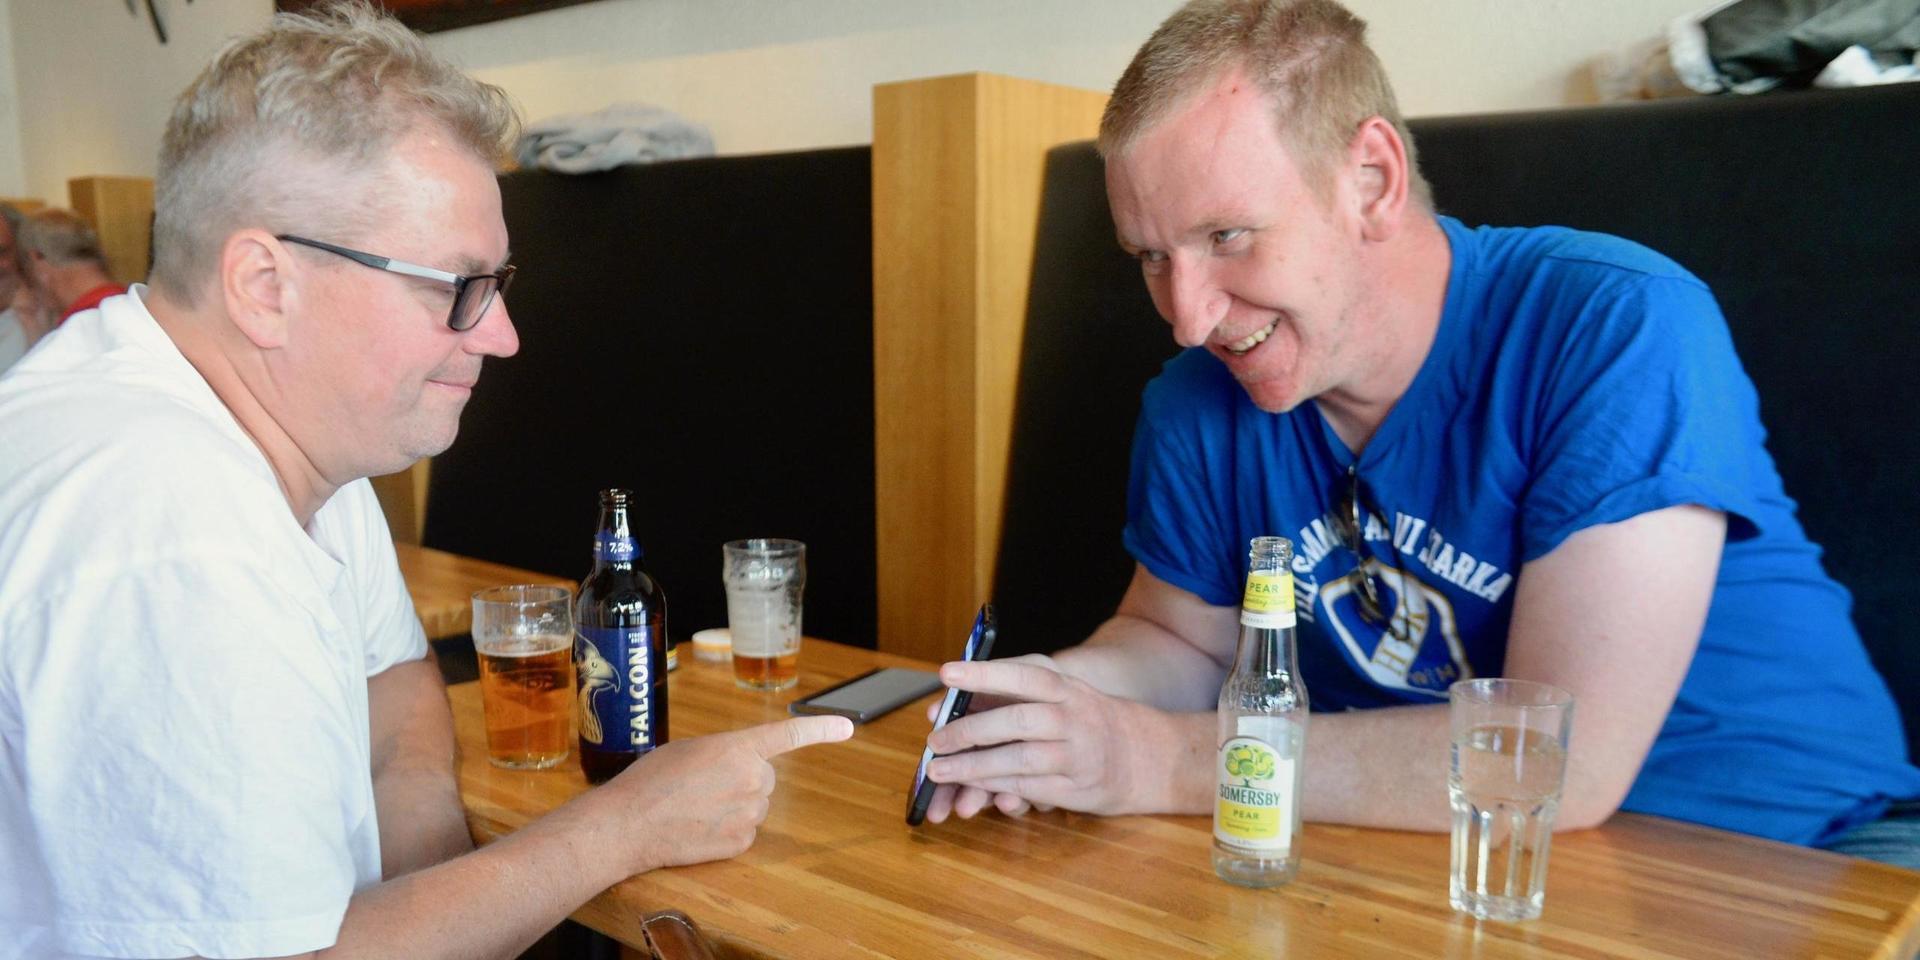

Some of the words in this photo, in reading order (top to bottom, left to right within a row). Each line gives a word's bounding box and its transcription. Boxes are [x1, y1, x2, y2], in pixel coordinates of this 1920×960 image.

[1393, 511, 1427, 555] VI
[609, 541, 634, 554] 7,2%
[1249, 582, 1279, 593] PEAR
[628, 645, 650, 745] FALCON
[1218, 783, 1280, 806] SOMERSBY
[1232, 809, 1260, 819] PEAR
